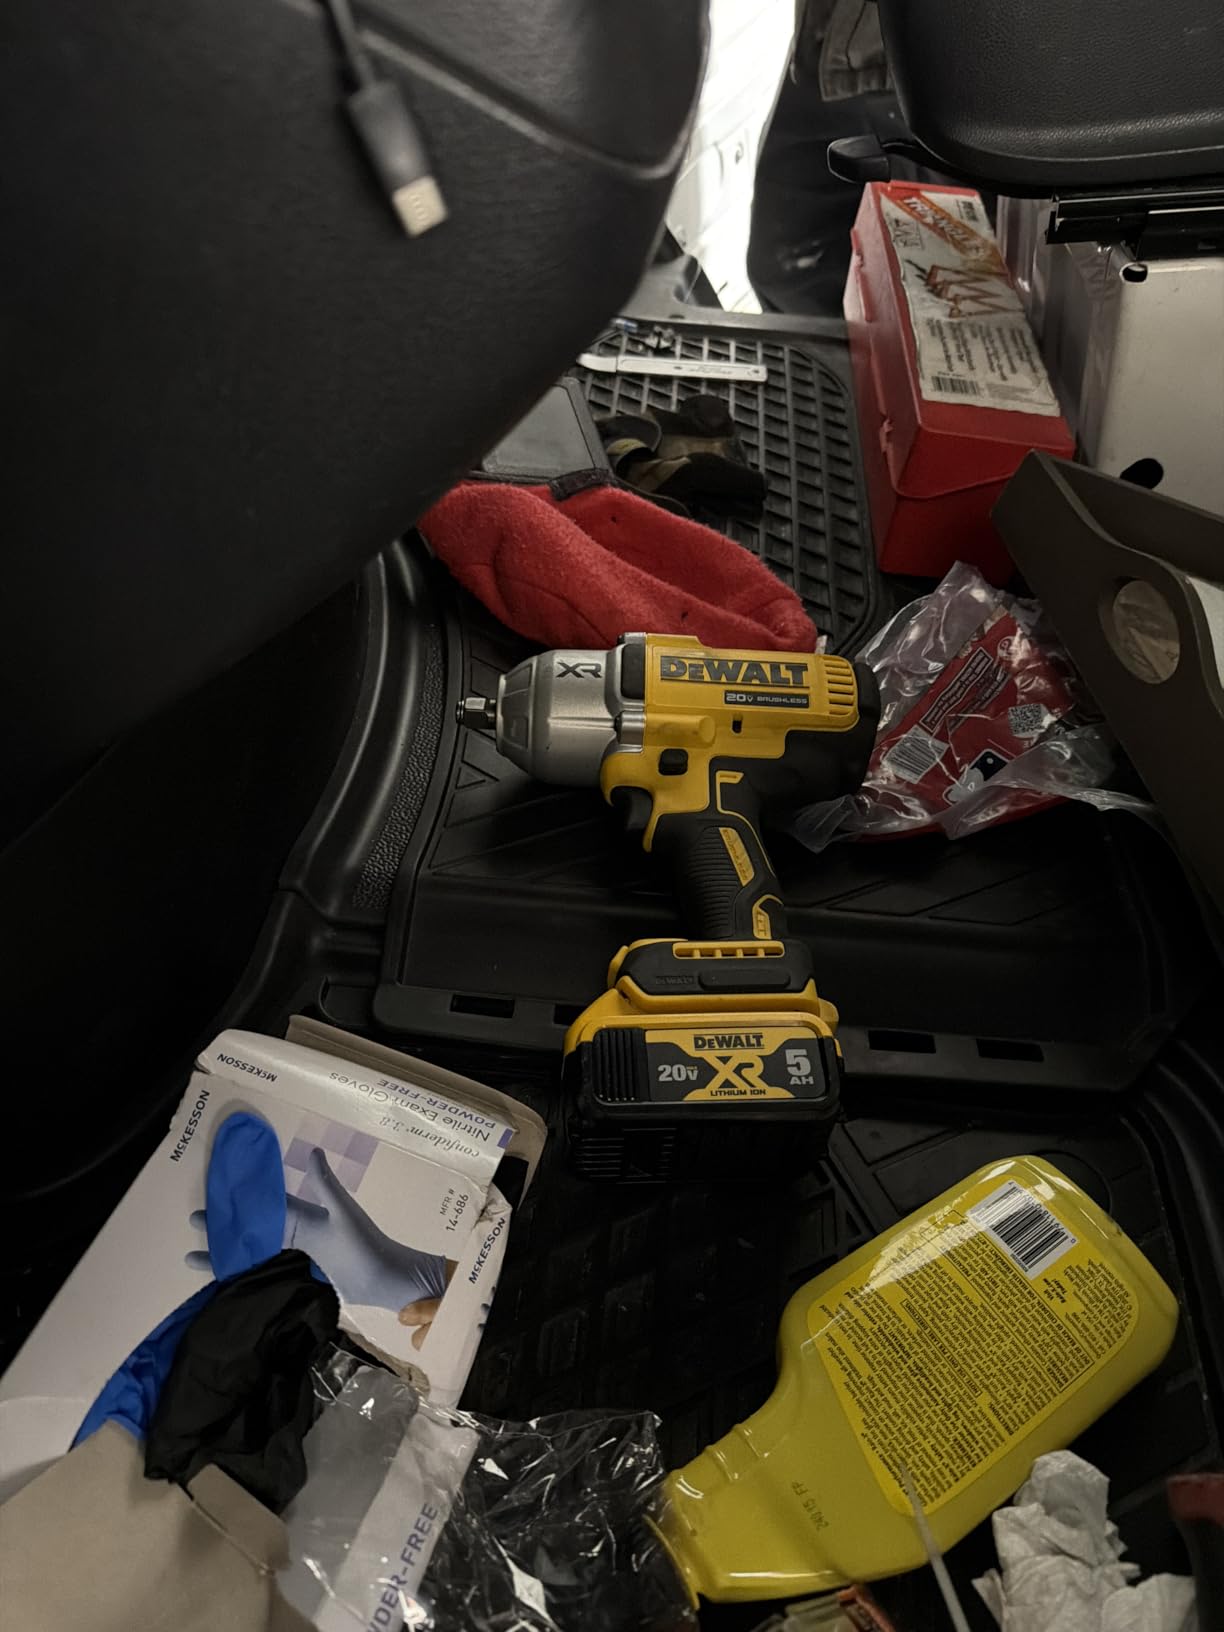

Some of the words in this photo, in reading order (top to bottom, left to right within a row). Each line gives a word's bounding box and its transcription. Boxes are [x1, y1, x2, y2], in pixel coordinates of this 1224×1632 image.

[556, 661, 603, 679] XR
[725, 693, 754, 703] 20V
[756, 695, 808, 704] BRUSHLESS
[657, 1063, 699, 1082] 20V
[703, 1055, 773, 1088] XR
[785, 1049, 812, 1077] 5
[329, 1072, 389, 1103] Gloves
[789, 1076, 815, 1086] AH
[710, 1088, 748, 1097] LITHIUM
[749, 1088, 767, 1096] ION
[376, 1078, 497, 1130] POWDER-FREE
[391, 1097, 438, 1122] Exam
[379, 1116, 405, 1132] 3.8
[442, 1115, 490, 1142] Nitrile
[439, 1196, 453, 1216] MFR
[445, 1194, 469, 1232] 14-686
